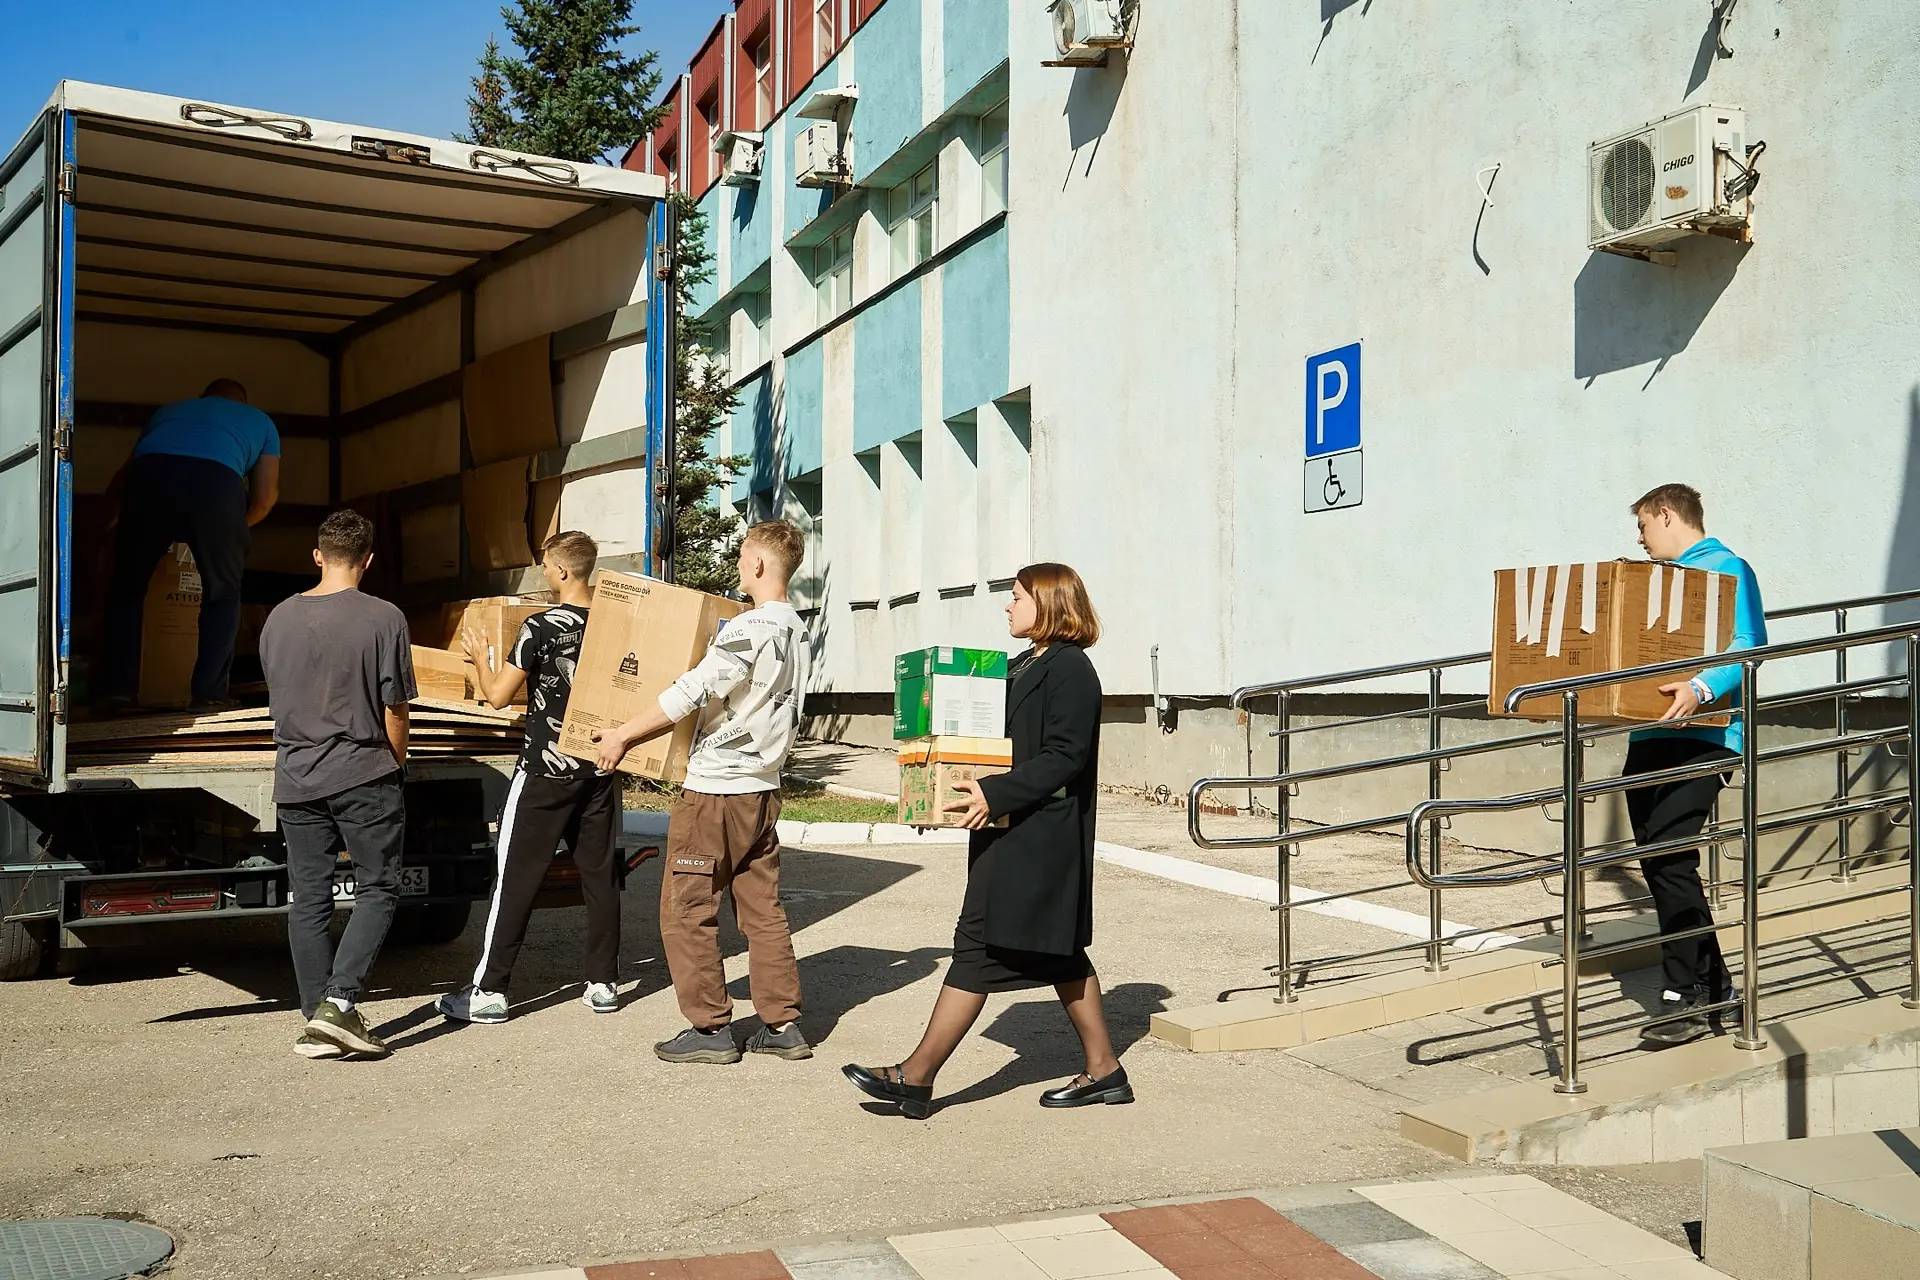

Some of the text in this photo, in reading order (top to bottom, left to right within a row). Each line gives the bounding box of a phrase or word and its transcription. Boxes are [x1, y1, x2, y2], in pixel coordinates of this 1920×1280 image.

[1663, 154, 1694, 172] CHIGO
[1316, 360, 1348, 444] P
[401, 869, 423, 886] 63
